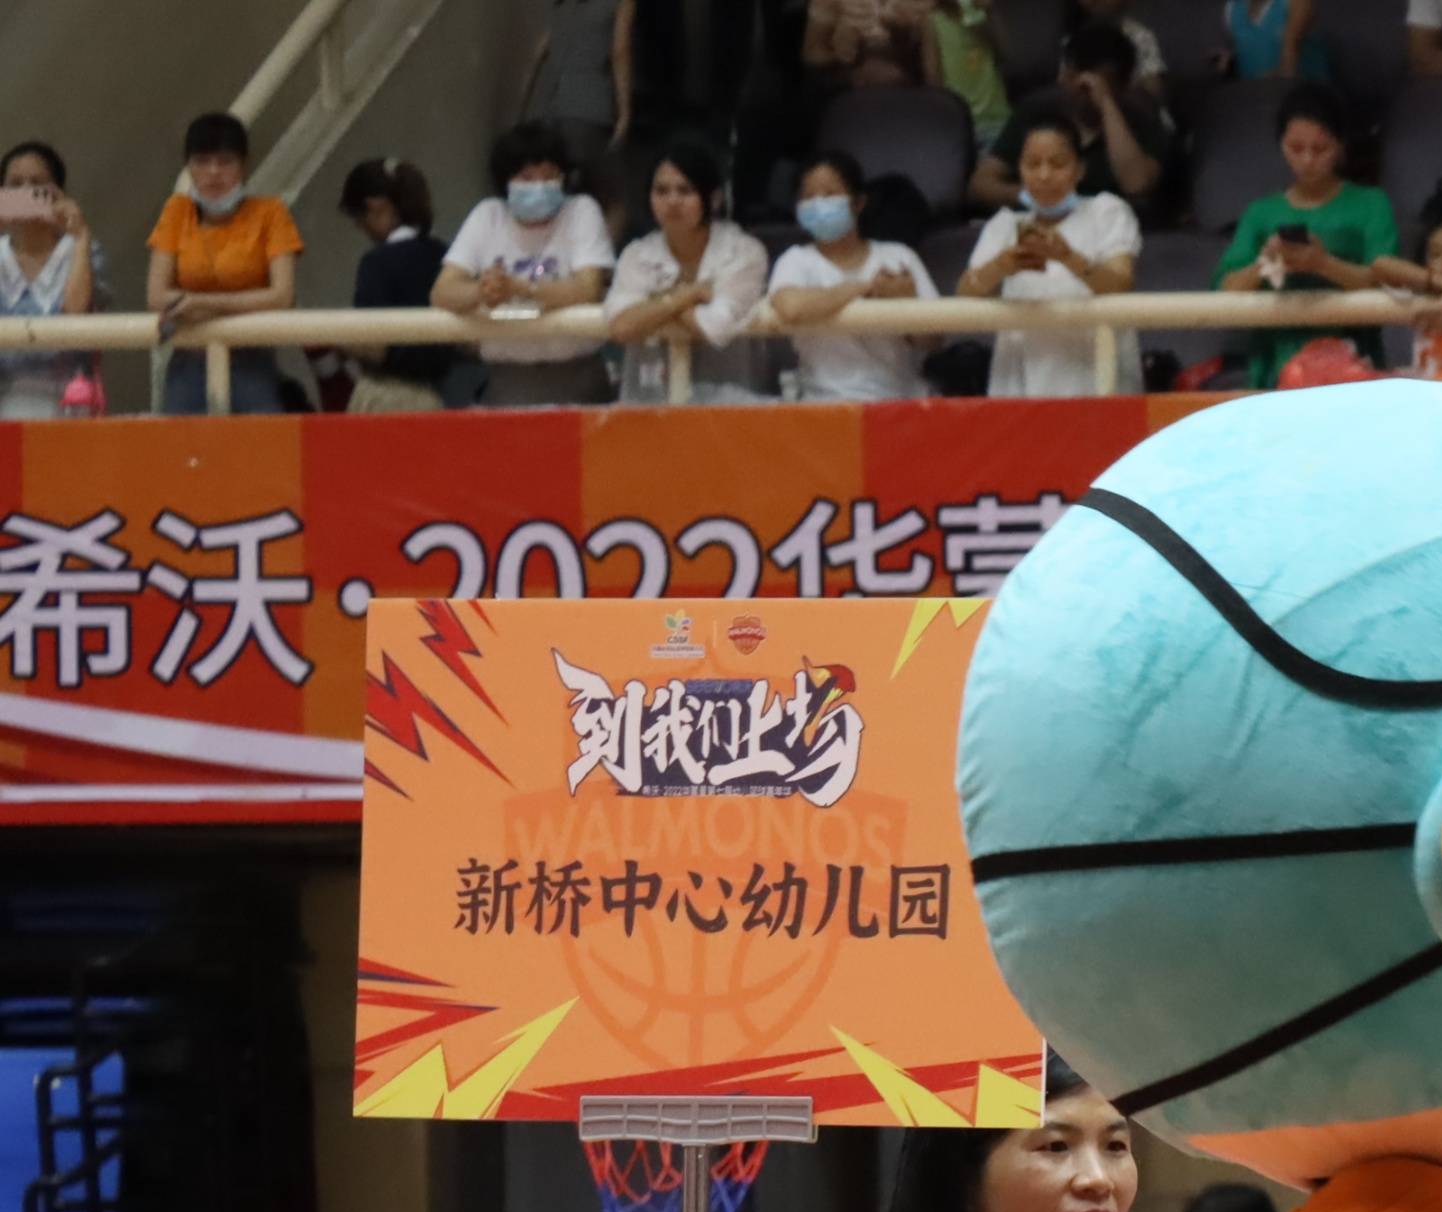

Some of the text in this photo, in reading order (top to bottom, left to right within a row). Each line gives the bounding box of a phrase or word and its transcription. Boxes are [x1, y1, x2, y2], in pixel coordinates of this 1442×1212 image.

[551, 647, 864, 808] 到我们上场
[453, 857, 951, 940] 新桥中心幼儿园
